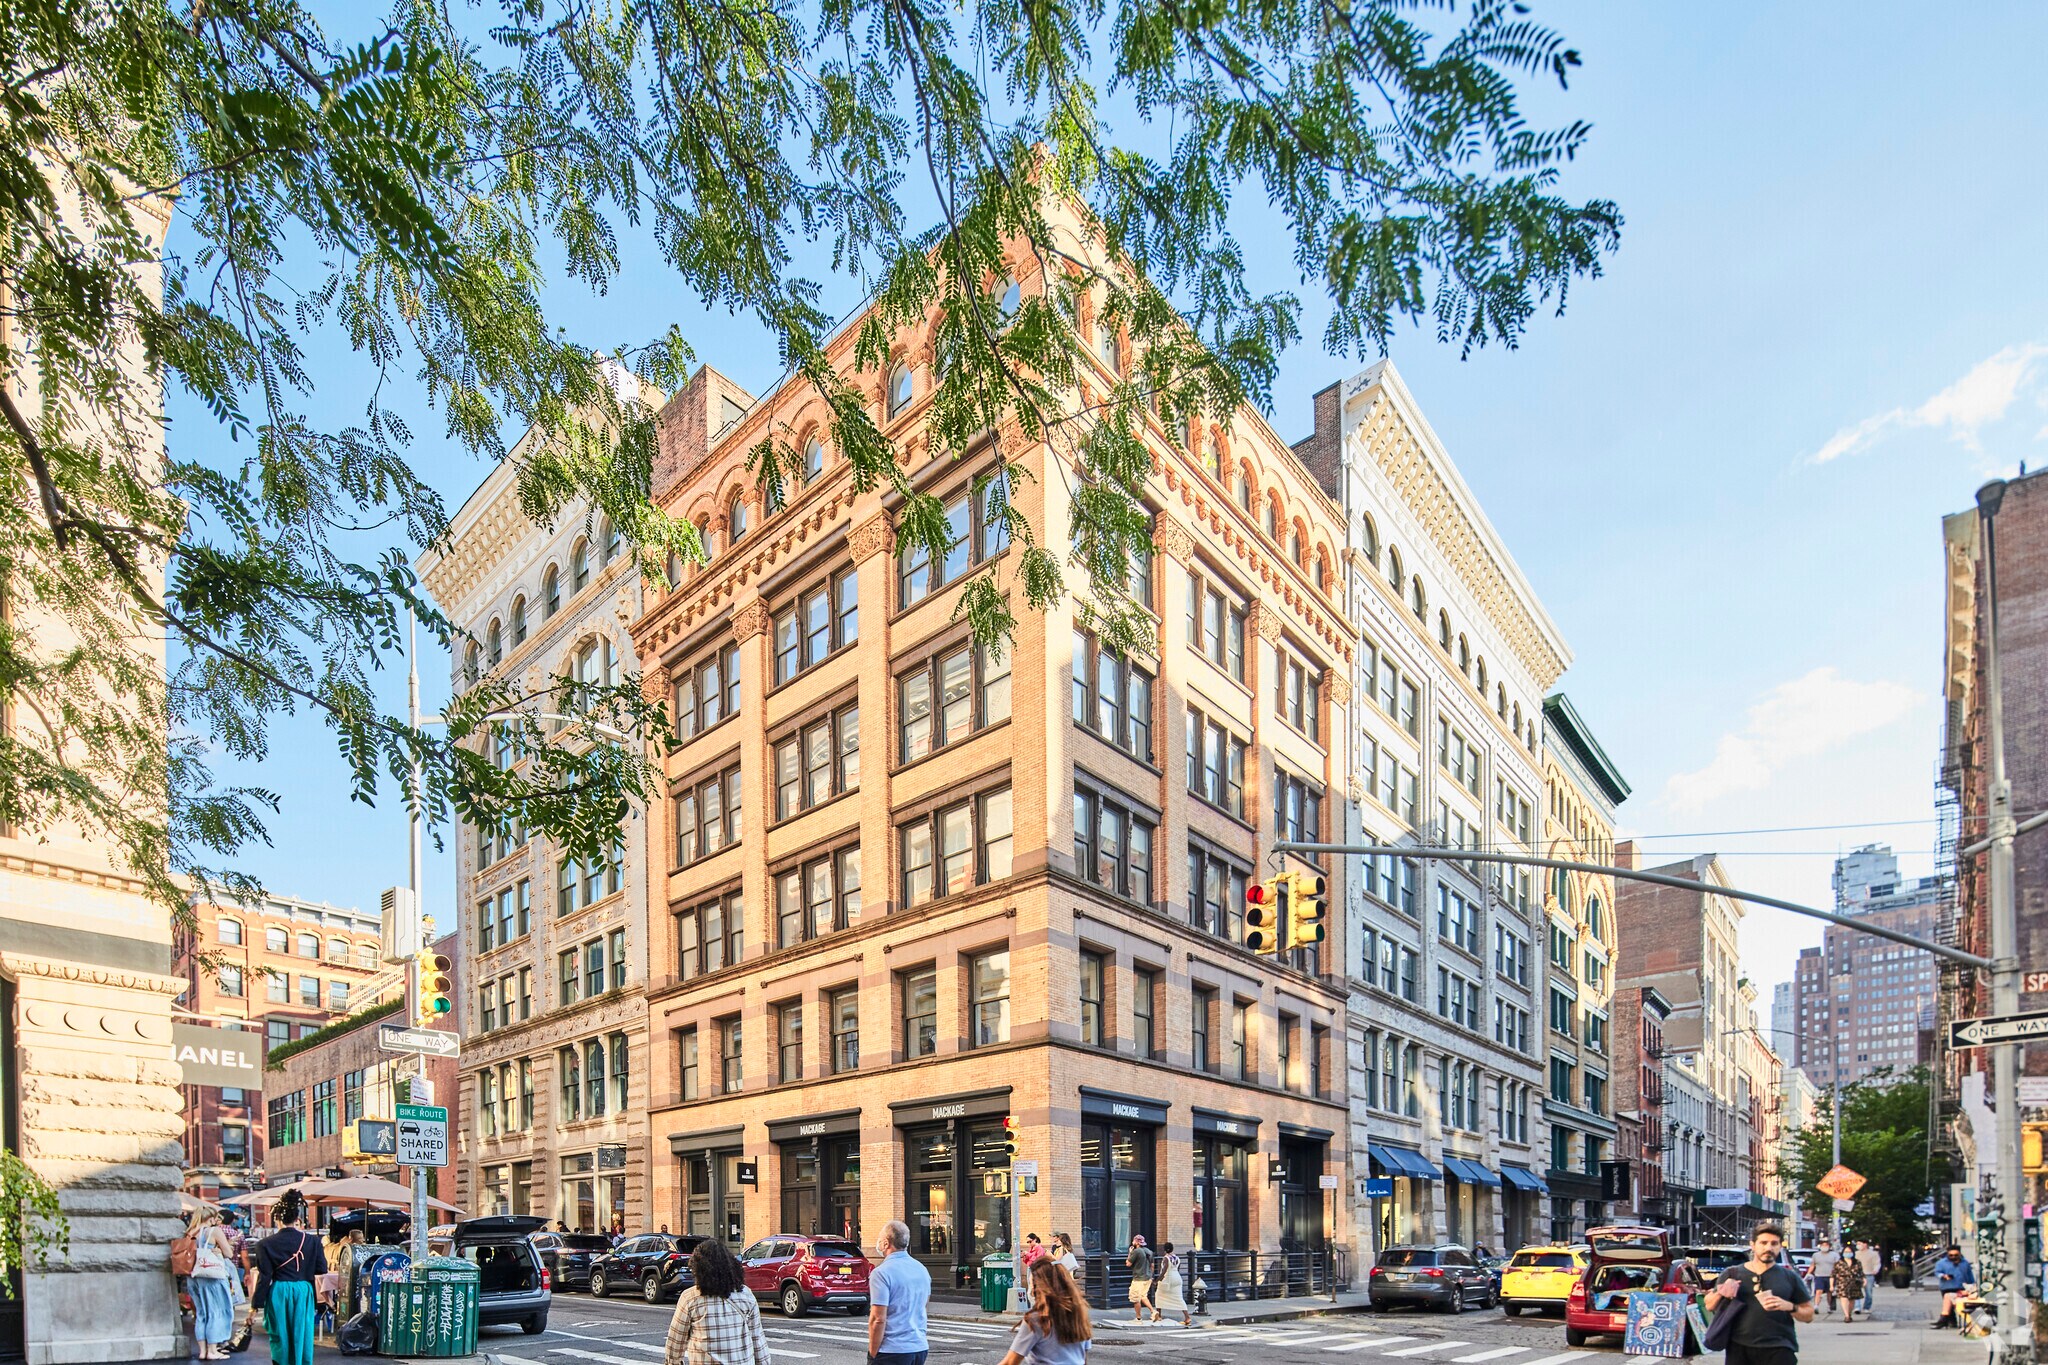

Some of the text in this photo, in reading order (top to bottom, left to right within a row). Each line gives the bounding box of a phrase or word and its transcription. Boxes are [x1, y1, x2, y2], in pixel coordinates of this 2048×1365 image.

[1968, 1020, 2048, 1038] ONE WAY
[388, 1032, 448, 1048] ONE WAY
[399, 1108, 443, 1119] BIKE ROUTE
[932, 1104, 965, 1118] MACKAGE
[1112, 1103, 1139, 1118] MACKAGE
[800, 1123, 826, 1135] MACKAGE
[1216, 1121, 1238, 1133] MACKAGE
[400, 1137, 444, 1150] SHARED
[408, 1150, 437, 1161] LANE
